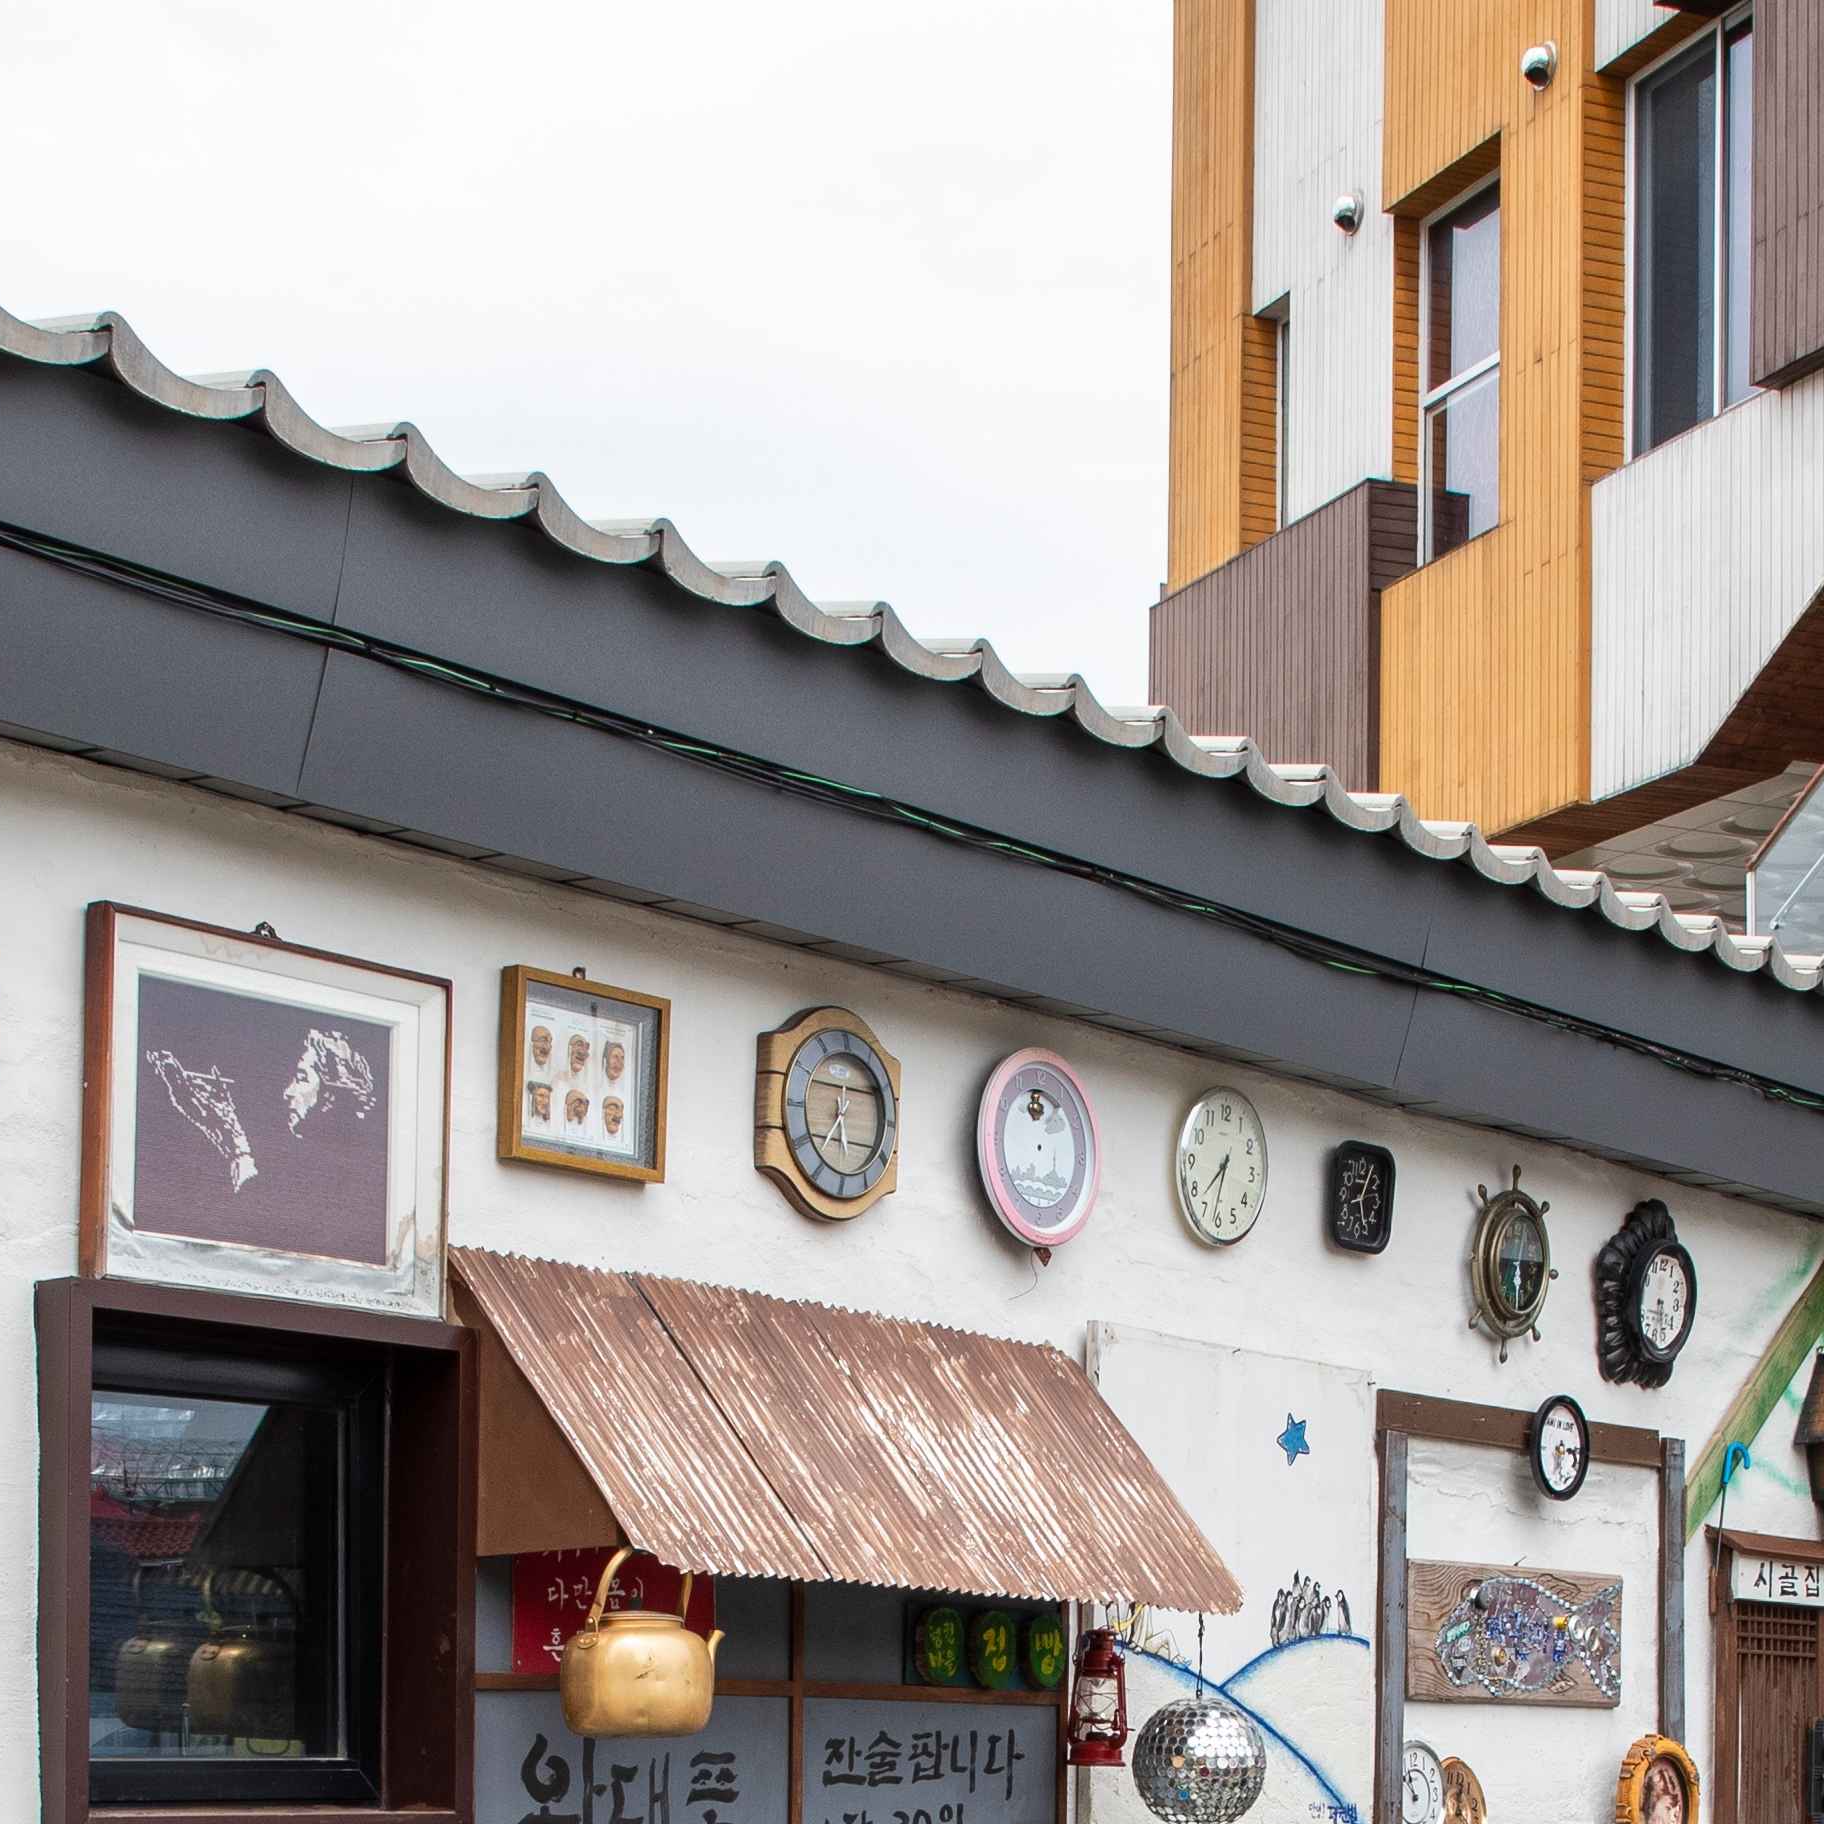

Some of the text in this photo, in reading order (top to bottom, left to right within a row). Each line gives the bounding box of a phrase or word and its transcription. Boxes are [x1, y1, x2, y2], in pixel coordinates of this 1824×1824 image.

[1206, 1110, 1215, 1127] 11
[1220, 1104, 1232, 1122] 12
[1238, 1117, 1243, 1134] 1
[1194, 1128, 1205, 1145] 10
[1246, 1138, 1254, 1155] 2
[1188, 1153, 1196, 1170] 9
[1247, 1167, 1255, 1183] 3
[1191, 1180, 1198, 1198] 8
[1241, 1191, 1248, 1208] 4
[1202, 1201, 1208, 1217] 7
[1229, 1208, 1237, 1224] 5
[1214, 1211, 1222, 1228] 6
[1753, 1560, 1820, 1598] 시골집
[822, 1729, 1026, 1802] 잔술팝니다
